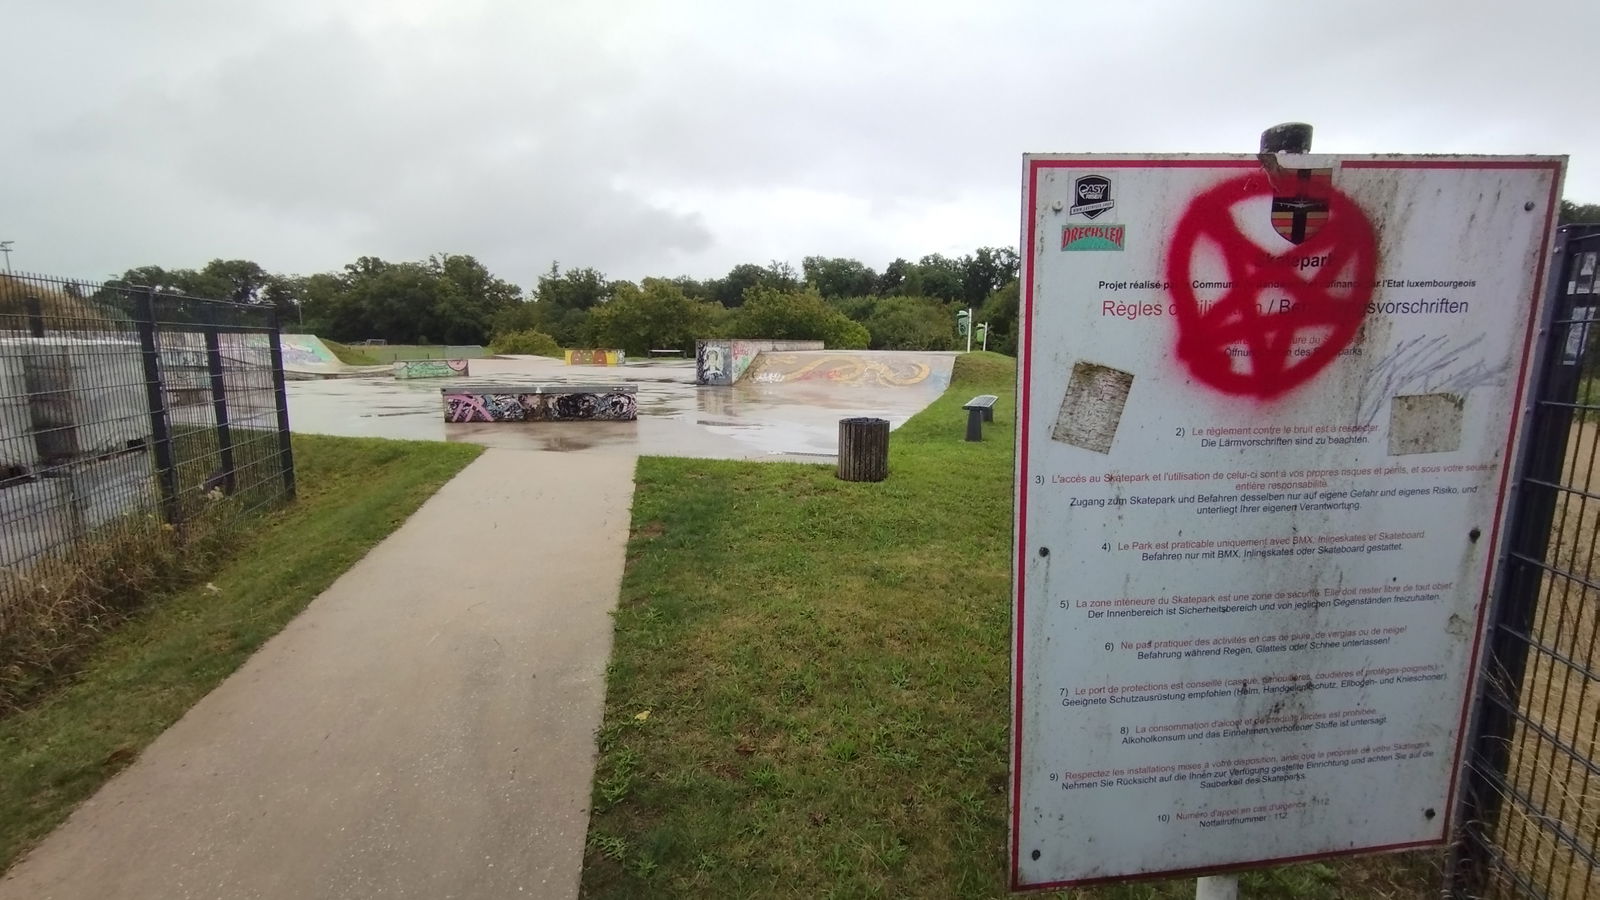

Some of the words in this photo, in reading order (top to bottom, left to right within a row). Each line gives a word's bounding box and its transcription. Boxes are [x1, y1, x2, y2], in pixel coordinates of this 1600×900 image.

[1062, 227, 1123, 249] DRECHSLER
[1099, 281, 1127, 290] Projet
[1130, 280, 1161, 289] réalisé
[1382, 280, 1404, 288] l'Etat
[1406, 280, 1476, 290] luxembourgeois
[1102, 300, 1162, 320] Règles
[1295, 348, 1311, 356] des
[1175, 428, 1185, 438] 2)
[1191, 427, 1203, 436] Le
[1205, 426, 1251, 437] règlement
[1252, 425, 1282, 434] contre
[1283, 425, 1292, 434] le
[1293, 424, 1314, 433] bruit
[1315, 424, 1328, 433] est
[1201, 438, 1216, 447] Die
[1218, 436, 1292, 446] Lärmvorschriften
[1294, 436, 1313, 444] sind
[1327, 434, 1369, 444] beachten.
[1035, 475, 1045, 485] 3)
[1103, 472, 1150, 483] Skatepark
[1152, 472, 1161, 480] et
[1163, 471, 1210, 480] l'utilisation
[1212, 470, 1223, 479] de
[1259, 469, 1278, 478] sont
[1306, 469, 1339, 478] propres
[1373, 465, 1382, 474] et
[1442, 463, 1463, 471] votre
[1070, 498, 1104, 508] Zugang
[1129, 495, 1175, 506] Skatepark
[1178, 494, 1194, 503] und
[1197, 493, 1237, 503] Befahren
[1240, 492, 1284, 501] desselben
[1303, 490, 1317, 499] auf
[1318, 490, 1347, 500] eigene
[1349, 488, 1379, 497] Gefahr
[1380, 487, 1396, 496] und
[1398, 487, 1430, 496] eigenes
[1461, 484, 1477, 493] und
[1196, 505, 1237, 515] unterliegt
[1239, 504, 1260, 513] Ihrer
[1262, 504, 1297, 513] eigenen
[1101, 542, 1111, 552] 4)
[1117, 542, 1129, 550] Le
[1131, 541, 1152, 549] Park
[1155, 541, 1169, 549] est
[1171, 539, 1214, 550] praticable
[1368, 532, 1377, 540] et
[1141, 552, 1182, 561] Befahren
[1201, 550, 1215, 559] mit
[1296, 547, 1315, 555] oder
[1317, 544, 1364, 554] Skateboard
[1059, 599, 1069, 609] 5)
[1076, 599, 1087, 607] La
[1158, 596, 1168, 604] du
[1171, 594, 1215, 604] Skatepark
[1217, 593, 1231, 602] est
[1087, 610, 1103, 618] Der
[1106, 607, 1163, 617] Innenbereich
[1165, 606, 1176, 614] ist
[1178, 603, 1257, 614] Sicherheitsbereich
[1258, 602, 1275, 610] und
[1104, 642, 1114, 651] 6)
[1154, 639, 1192, 649] pratiquer
[1137, 650, 1181, 658] Befahrung
[1184, 647, 1221, 656] während
[1059, 688, 1068, 696] 7)
[1075, 687, 1086, 695] Le
[1088, 686, 1105, 695] port
[1108, 685, 1118, 693] de
[1170, 681, 1183, 689] est
[1062, 697, 1106, 706] Geeignete
[1120, 726, 1129, 735] 8)
[1121, 734, 1185, 744] Alkoholkonsum
[1187, 732, 1203, 740] und
[1049, 773, 1058, 782] 9)
